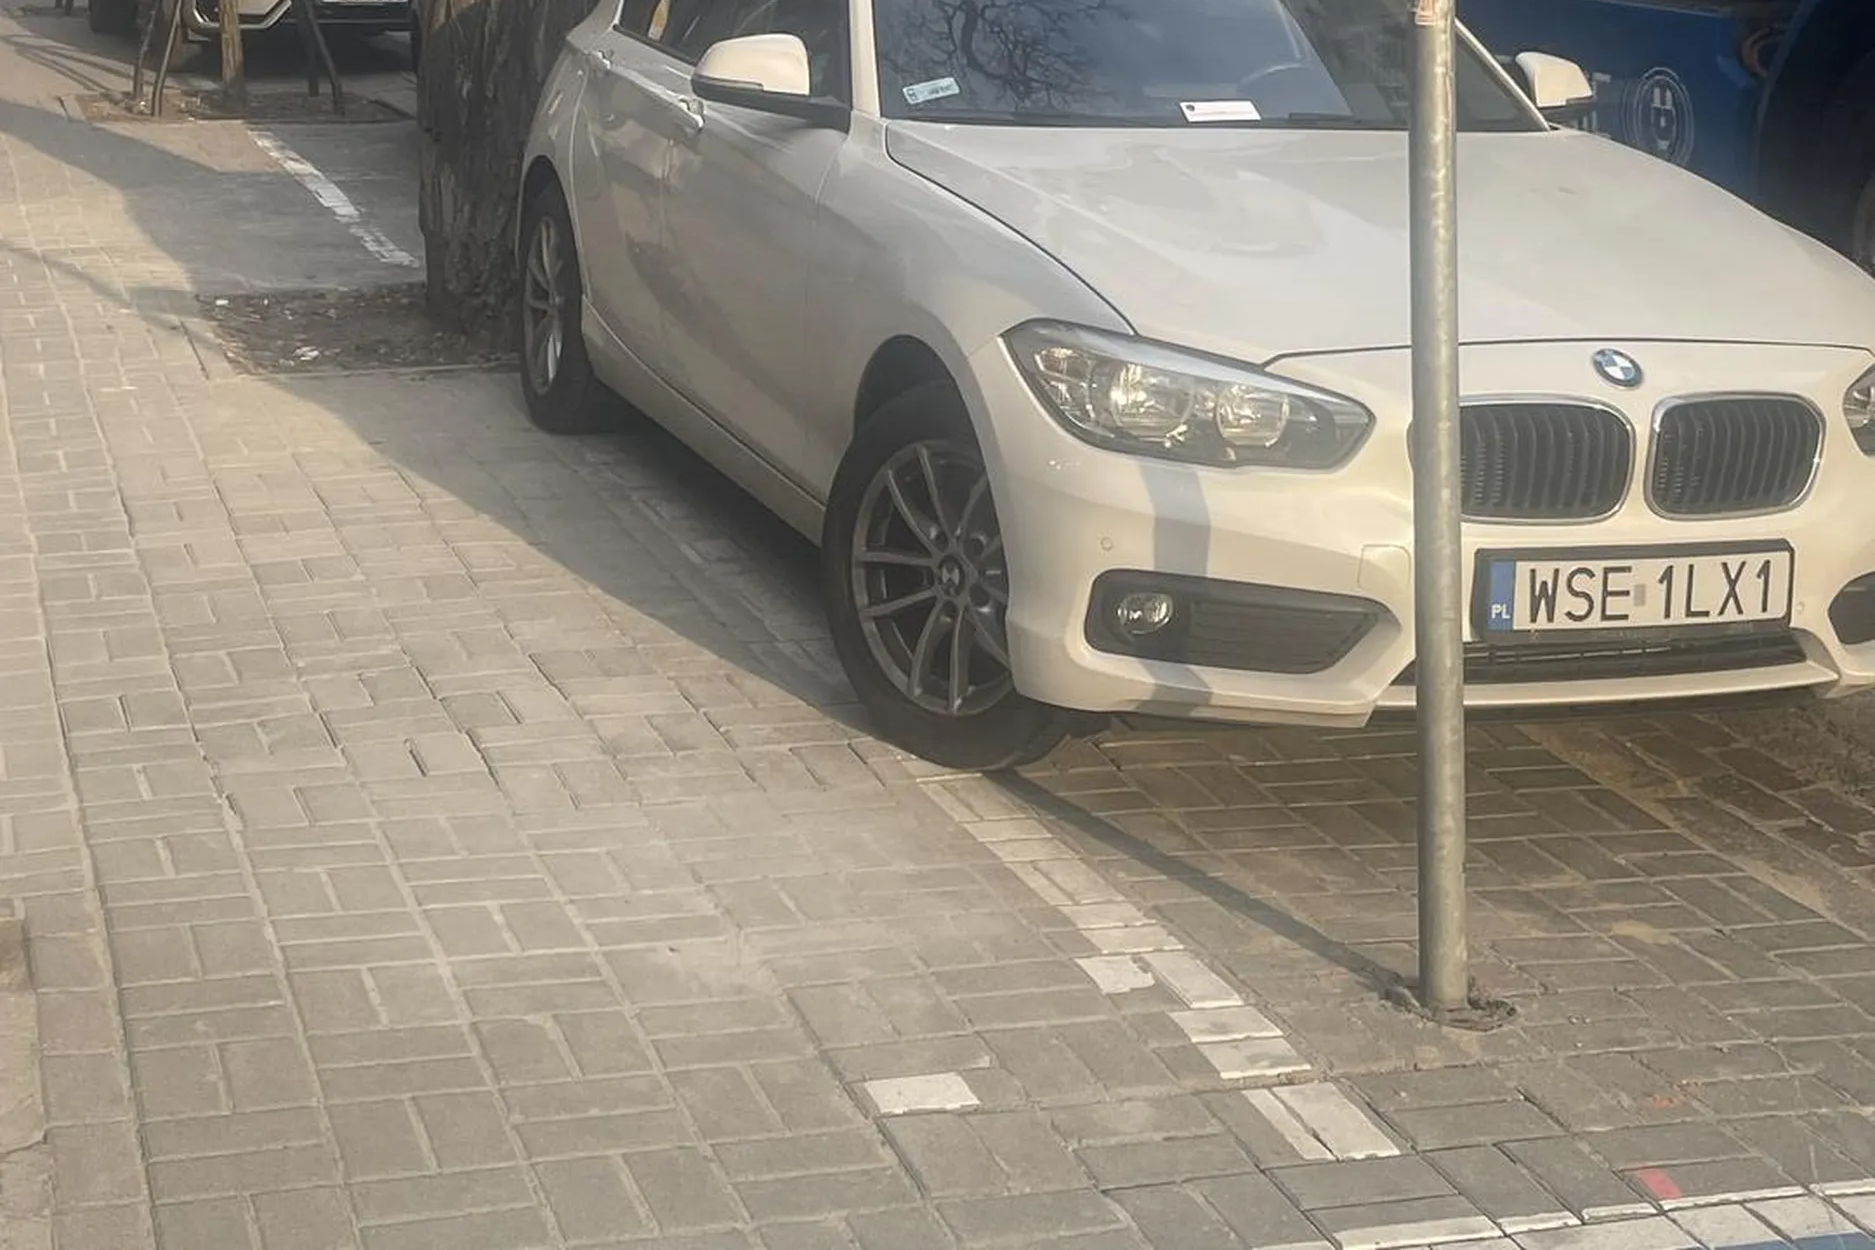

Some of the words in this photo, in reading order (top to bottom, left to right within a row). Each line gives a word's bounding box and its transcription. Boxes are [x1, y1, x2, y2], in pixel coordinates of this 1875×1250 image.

[1491, 603, 1511, 620] PL
[1528, 564, 1633, 624] WSE
[1657, 558, 1772, 620] 1LX1
